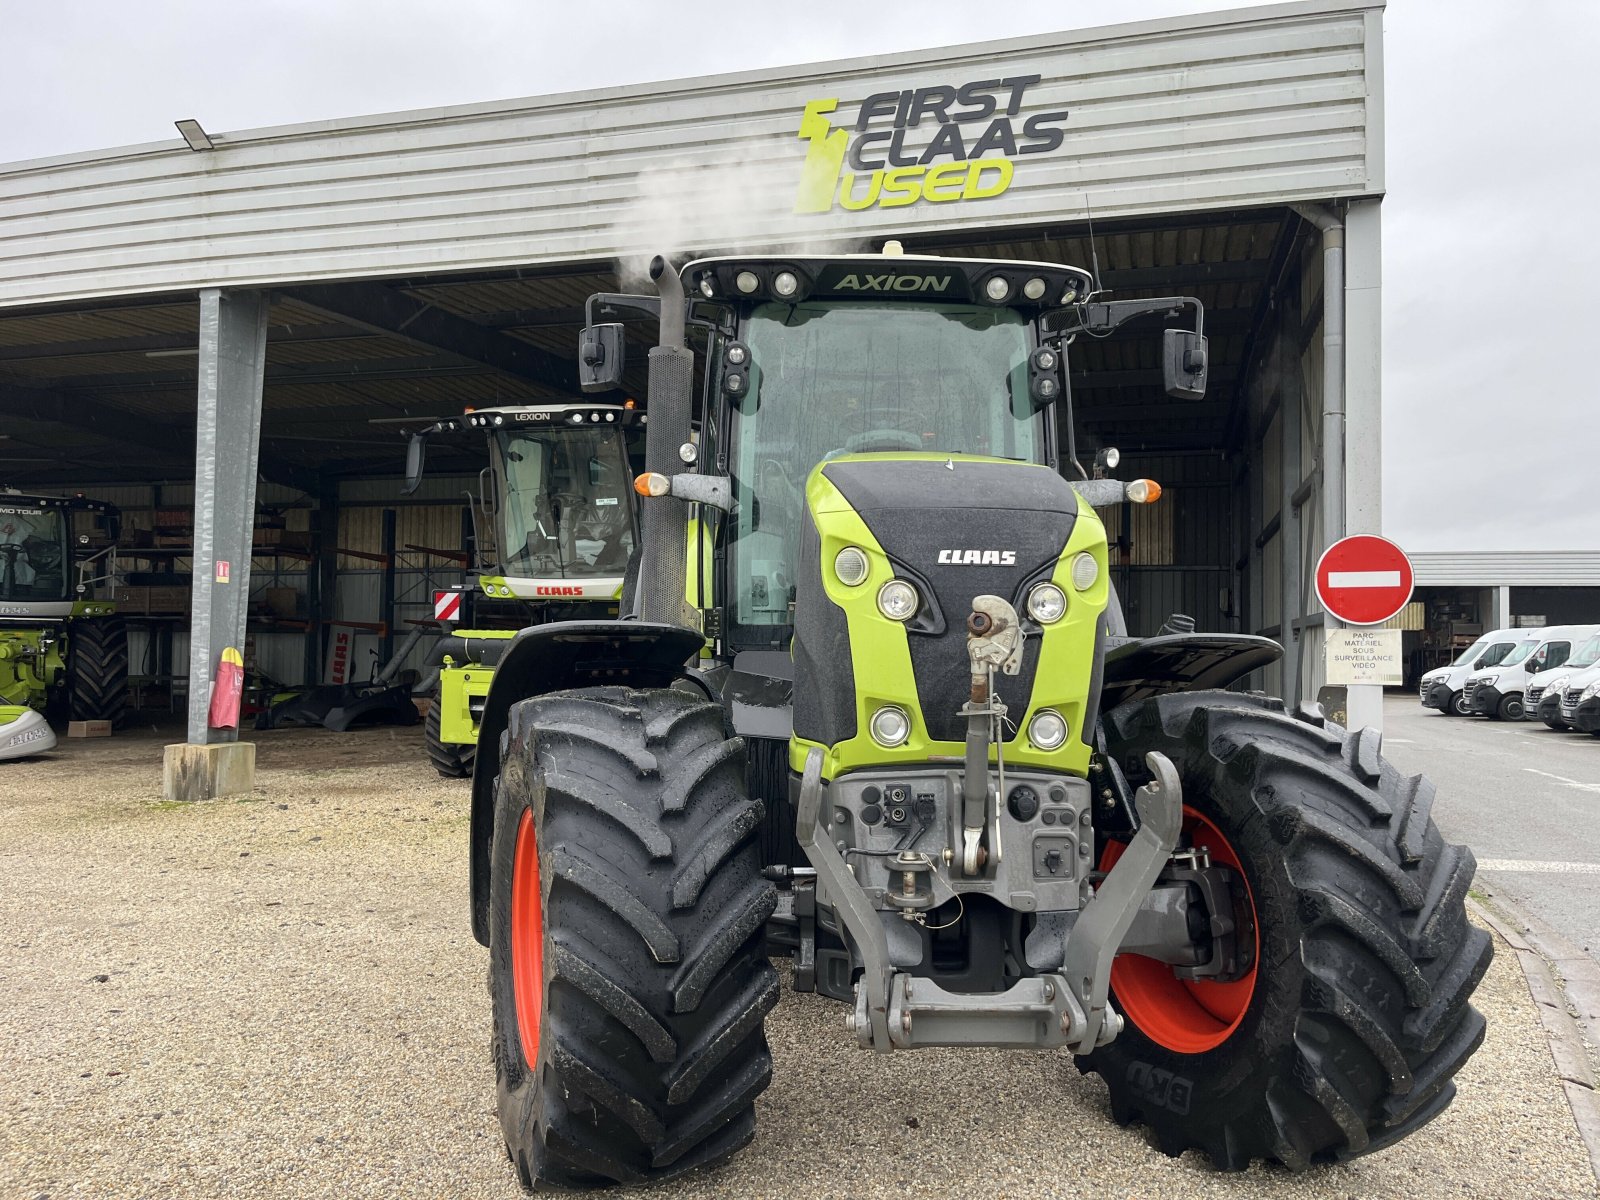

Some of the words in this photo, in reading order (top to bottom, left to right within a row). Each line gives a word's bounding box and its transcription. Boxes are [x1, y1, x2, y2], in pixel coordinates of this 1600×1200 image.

[855, 74, 1041, 132] FIRST
[848, 111, 1069, 170] CLAAS
[839, 158, 1014, 211] USED
[833, 274, 952, 292] AXION
[515, 413, 551, 421] LEXION
[16, 508, 42, 516] TOUR
[938, 549, 1016, 565] CLAAS
[536, 586, 584, 596] CLAAS
